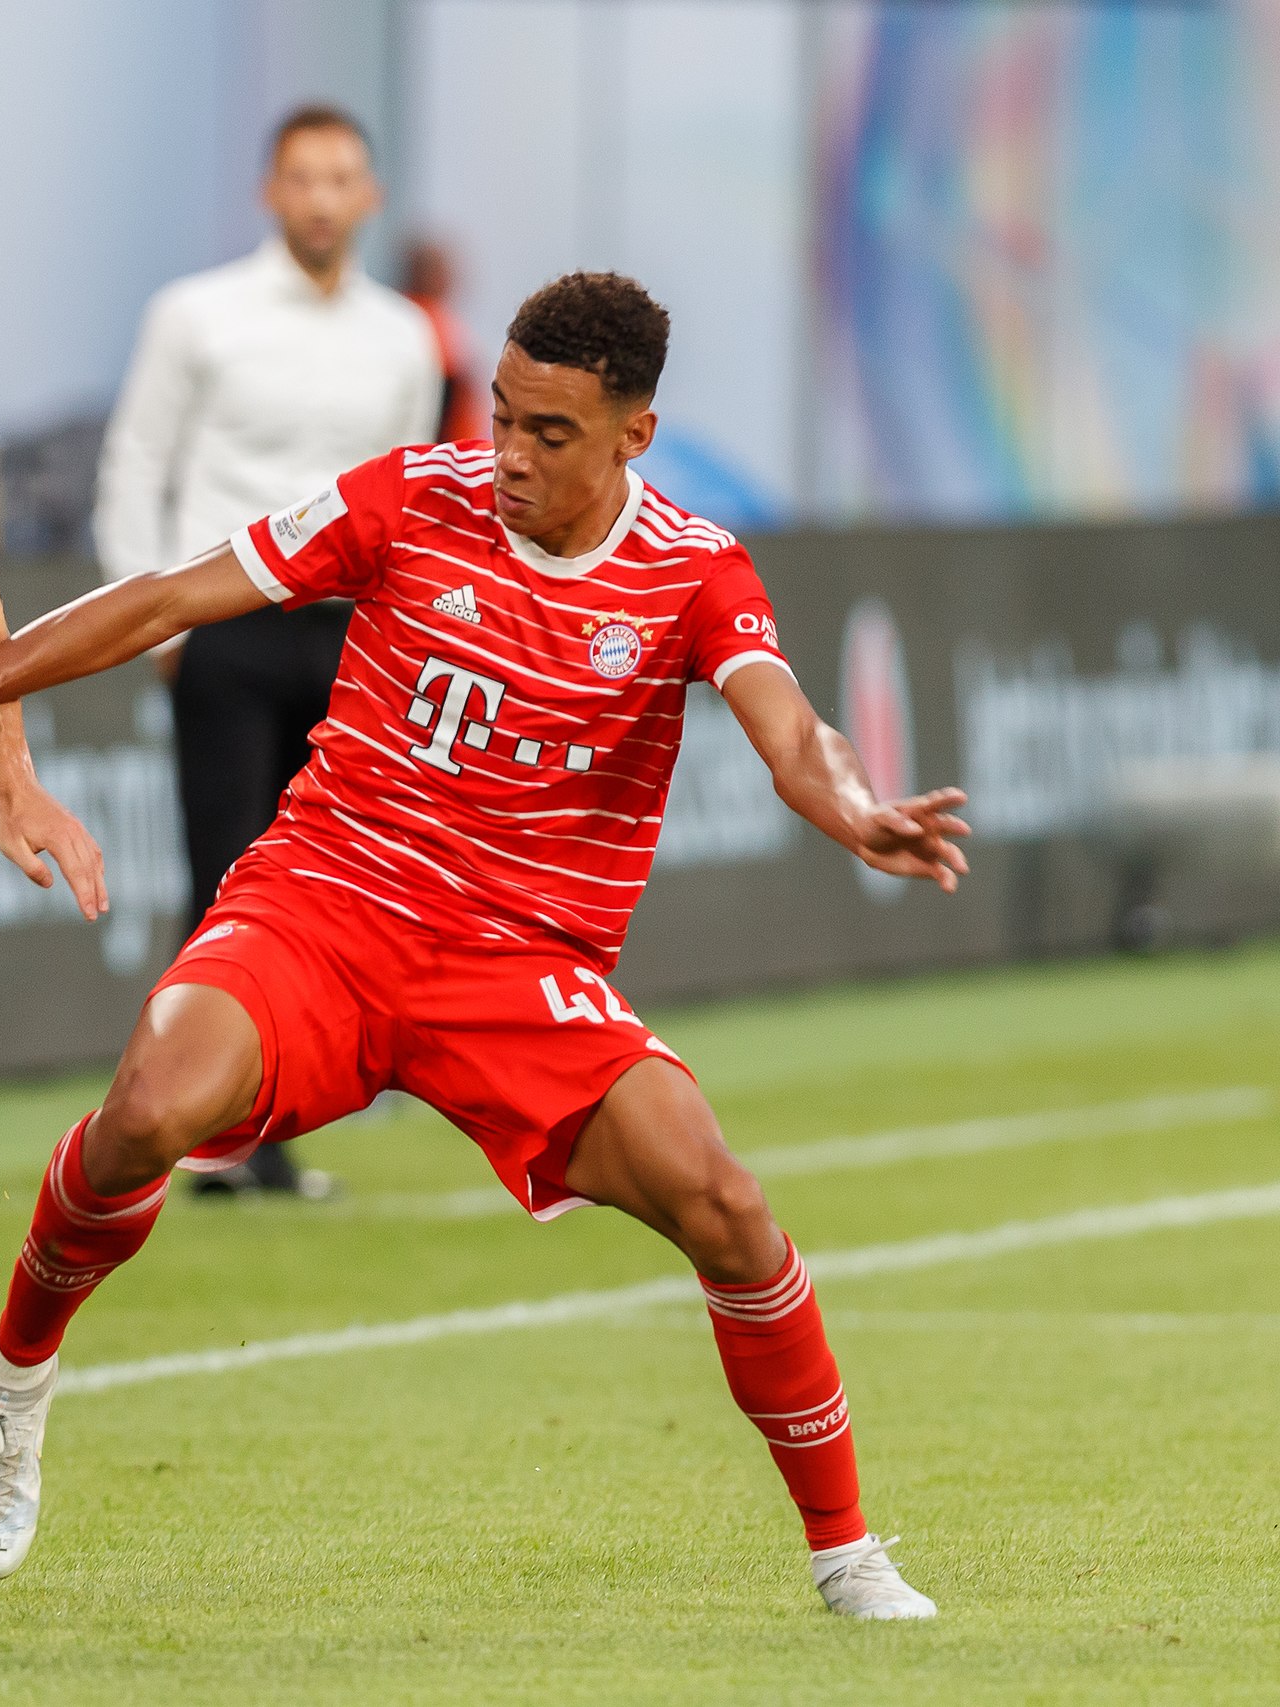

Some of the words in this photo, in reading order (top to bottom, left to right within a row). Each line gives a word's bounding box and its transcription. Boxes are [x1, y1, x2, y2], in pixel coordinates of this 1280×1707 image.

[432, 597, 482, 624] adidas
[595, 632, 607, 648] FC
[606, 627, 638, 650] BAYERN
[734, 612, 778, 640] QAT
[538, 966, 645, 1028] 42
[787, 1394, 848, 1437] BAYER
